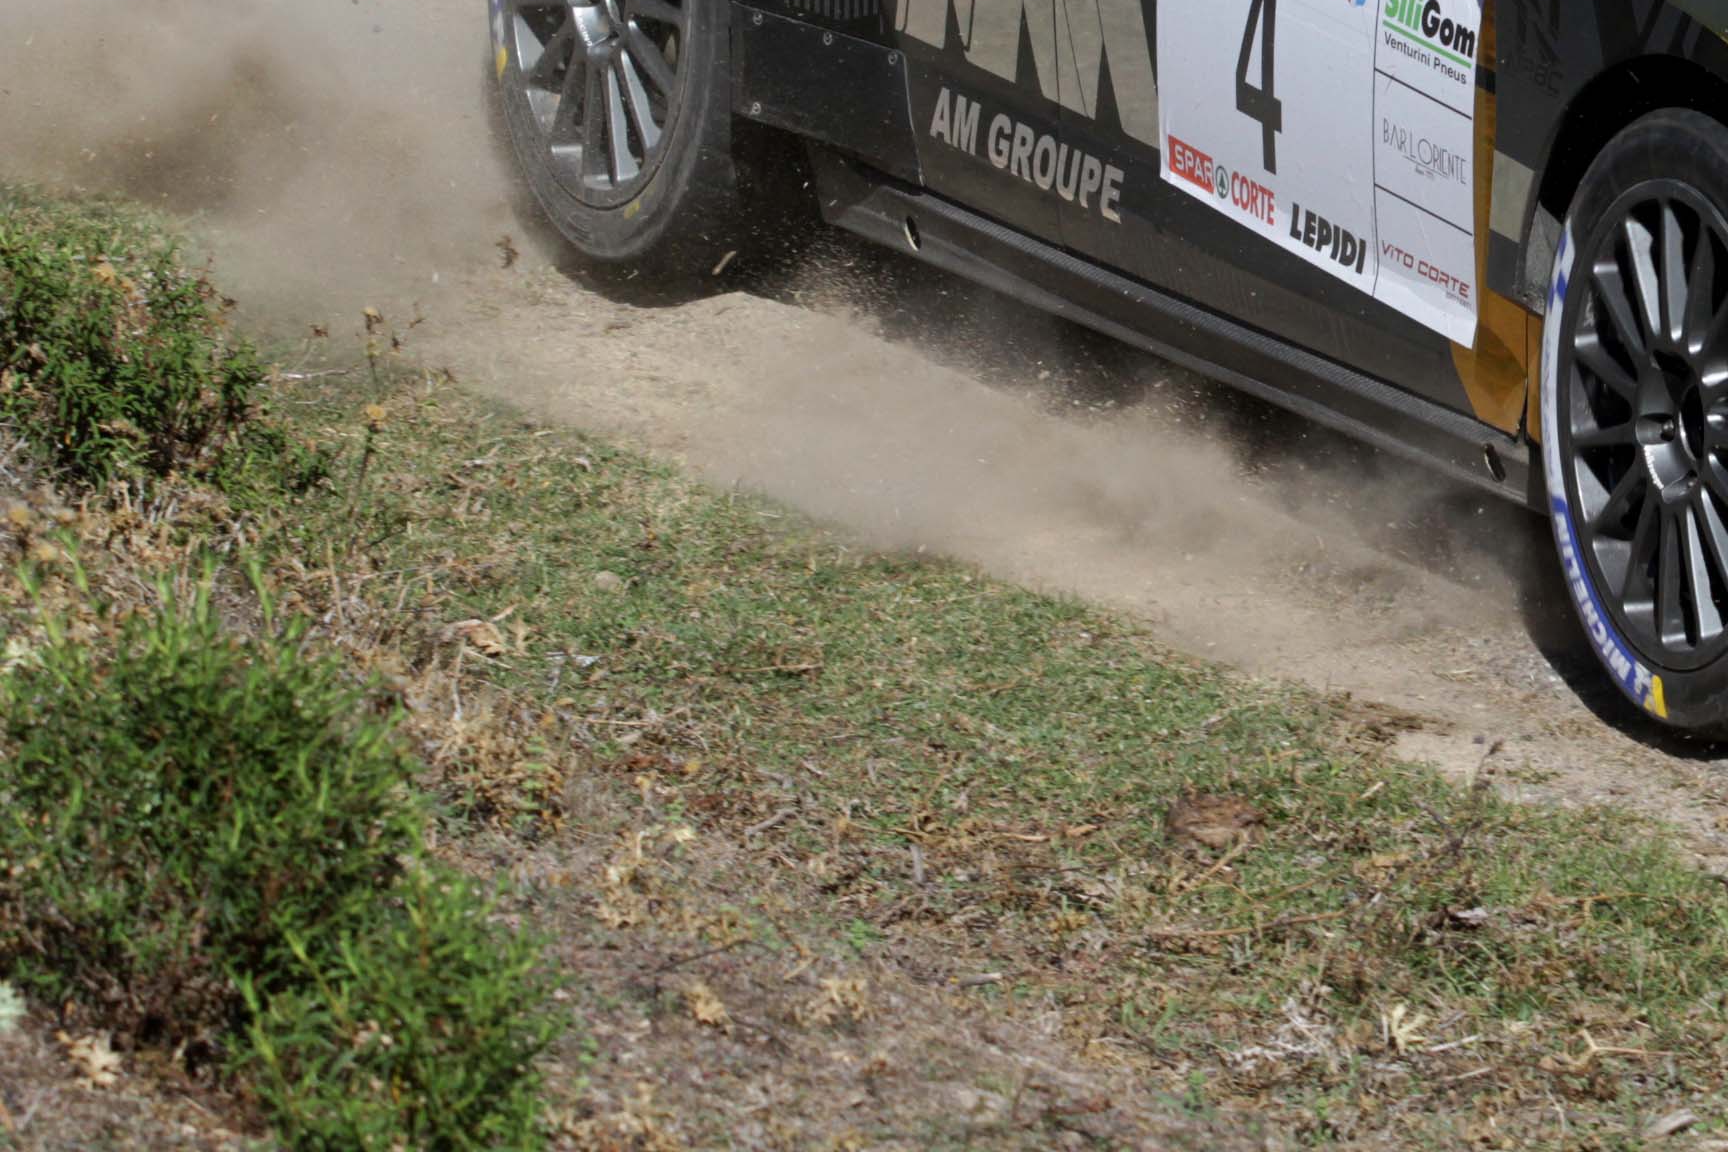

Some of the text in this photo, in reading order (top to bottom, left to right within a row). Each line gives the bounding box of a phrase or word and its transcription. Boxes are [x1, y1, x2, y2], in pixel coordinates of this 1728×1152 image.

[1384, 31, 1431, 66] Venturini
[1433, 56, 1467, 84] Pneus
[930, 87, 1125, 225] AM GROUPE
[1384, 117, 1407, 153] BAR
[1175, 144, 1214, 191] SPAR
[1231, 171, 1275, 226] CORTE
[1290, 202, 1367, 274] LEPIDI
[1417, 260, 1470, 299] CORTE
[1554, 512, 1632, 682] MICHELIN
